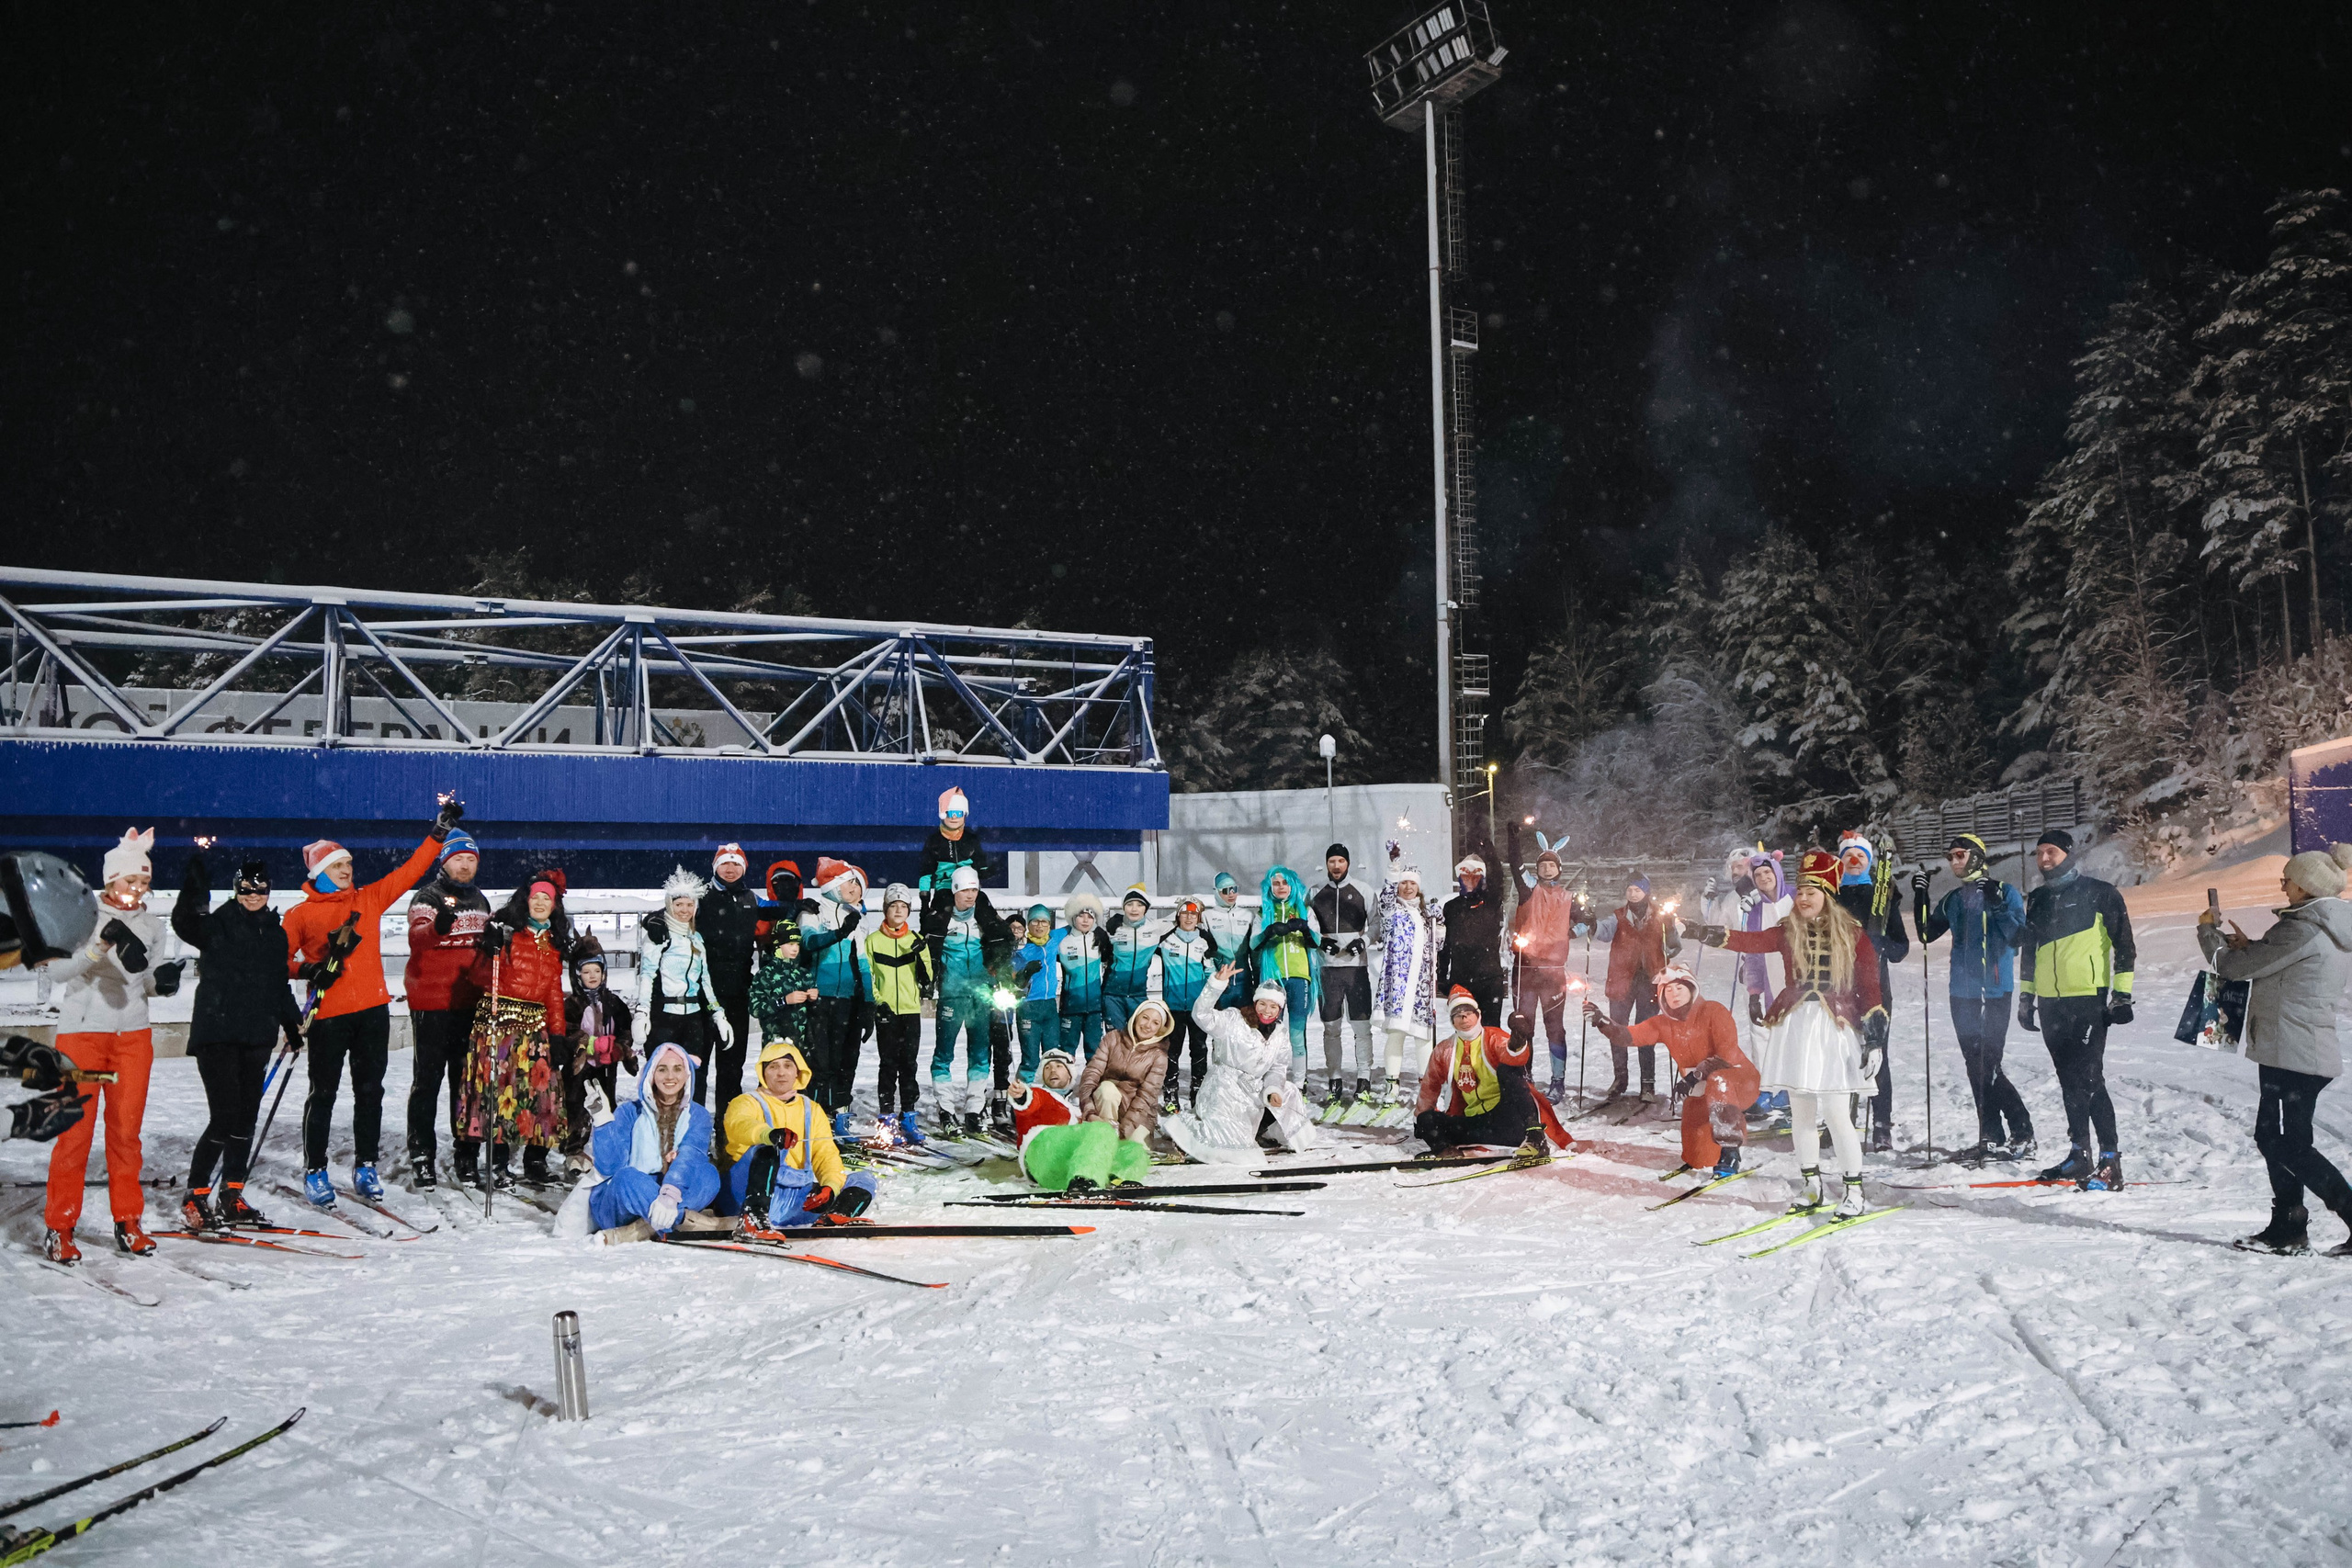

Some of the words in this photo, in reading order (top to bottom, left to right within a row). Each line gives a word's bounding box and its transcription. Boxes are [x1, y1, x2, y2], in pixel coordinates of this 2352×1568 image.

[1871, 860, 1884, 917] FISCHER
[1878, 860, 1892, 917] FISCHER
[1507, 1157, 1552, 1170] FISCHER
